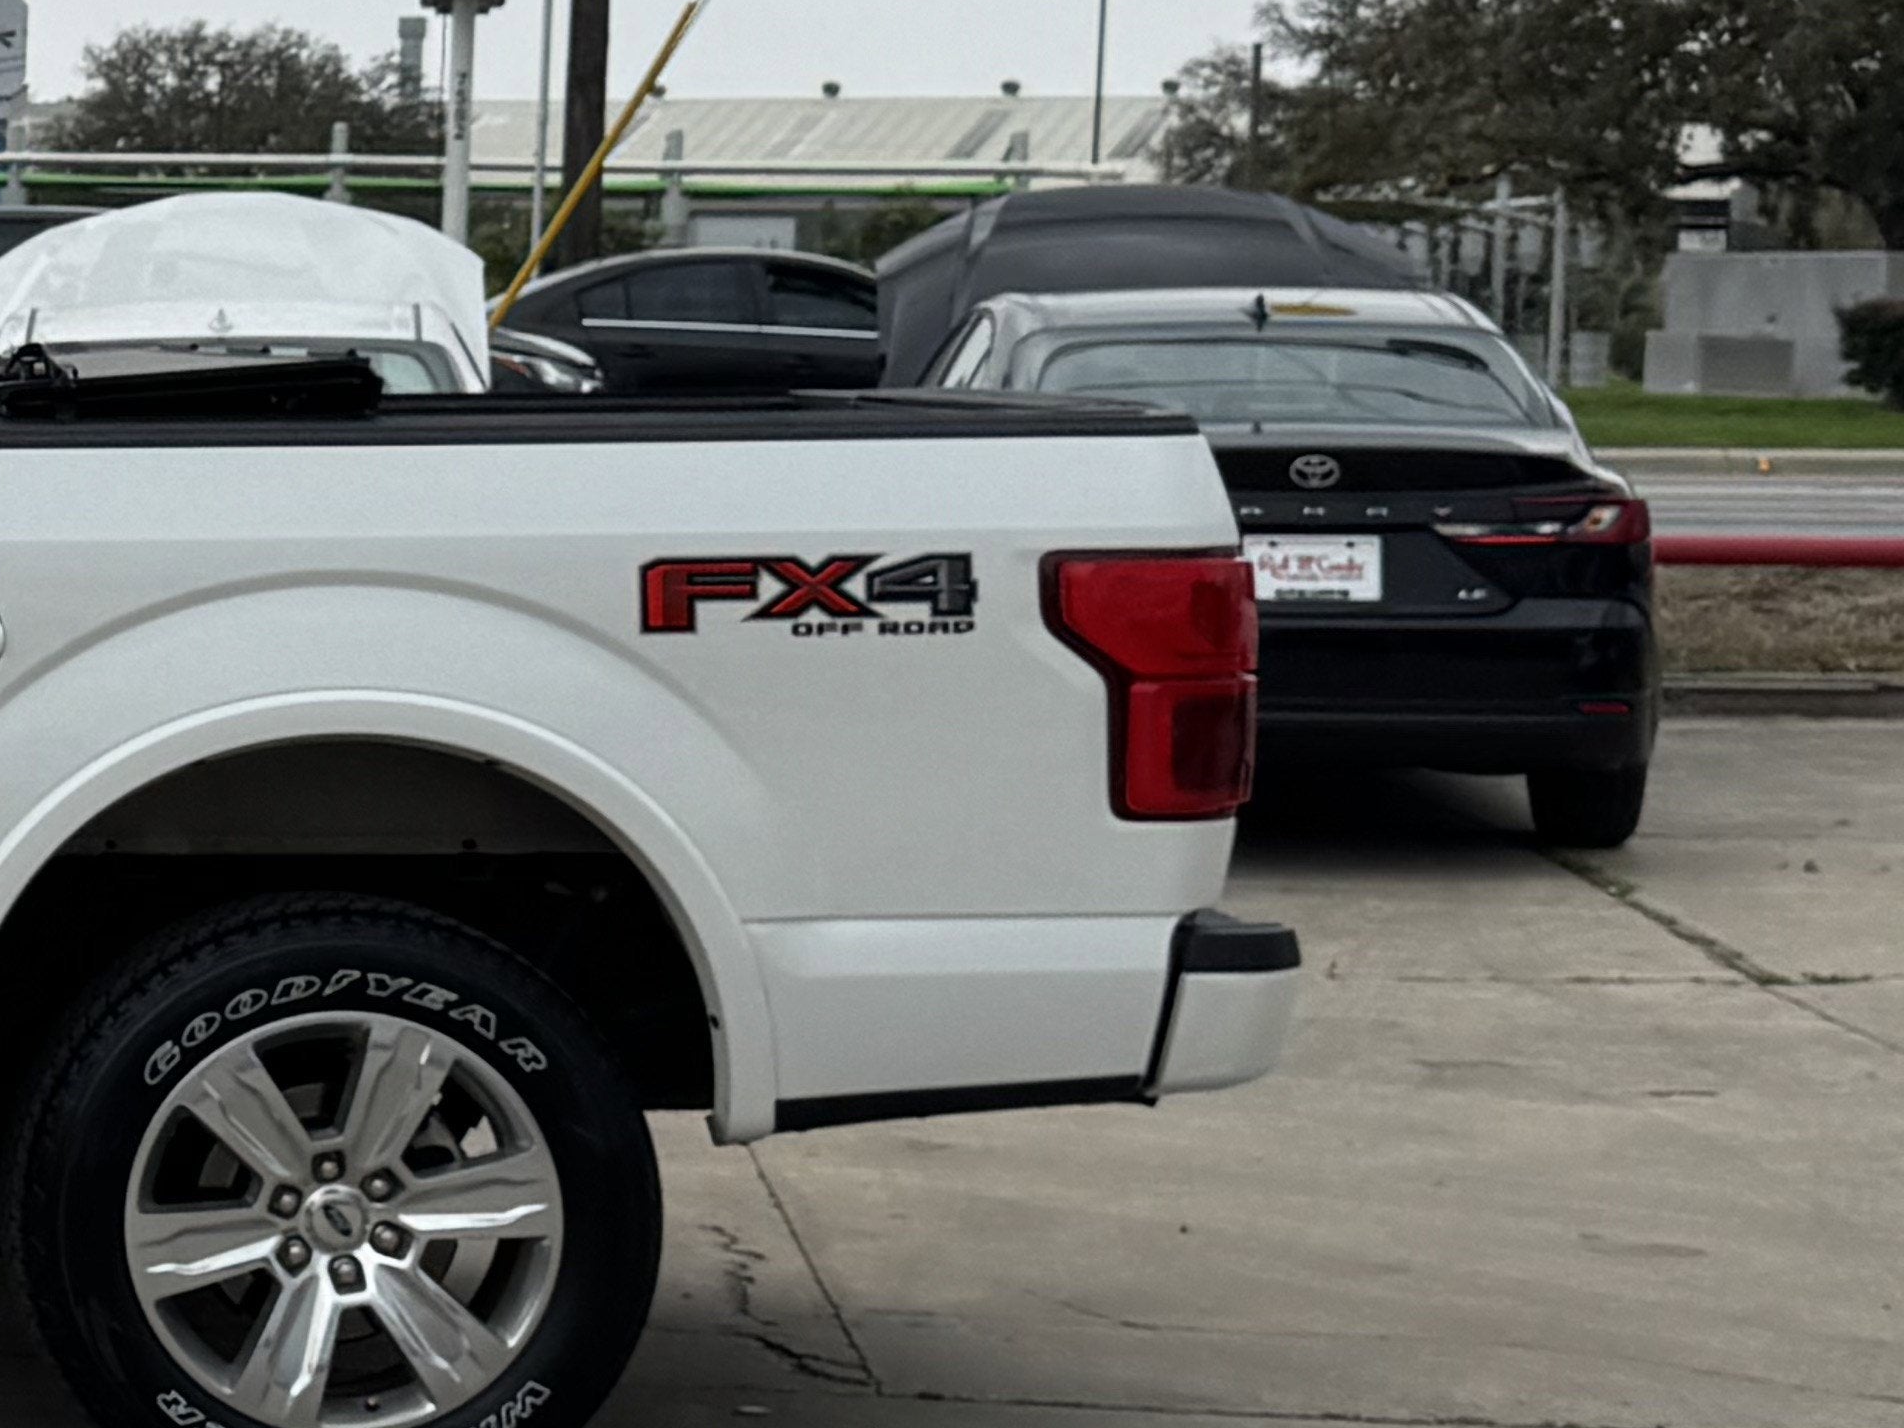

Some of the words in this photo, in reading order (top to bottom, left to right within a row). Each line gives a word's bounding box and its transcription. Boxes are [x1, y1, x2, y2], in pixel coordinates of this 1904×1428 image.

[639, 552, 979, 634] FX4
[792, 619, 865, 638] OFF
[877, 618, 976, 636] ROAD
[143, 969, 549, 1085] GOODYEAR
